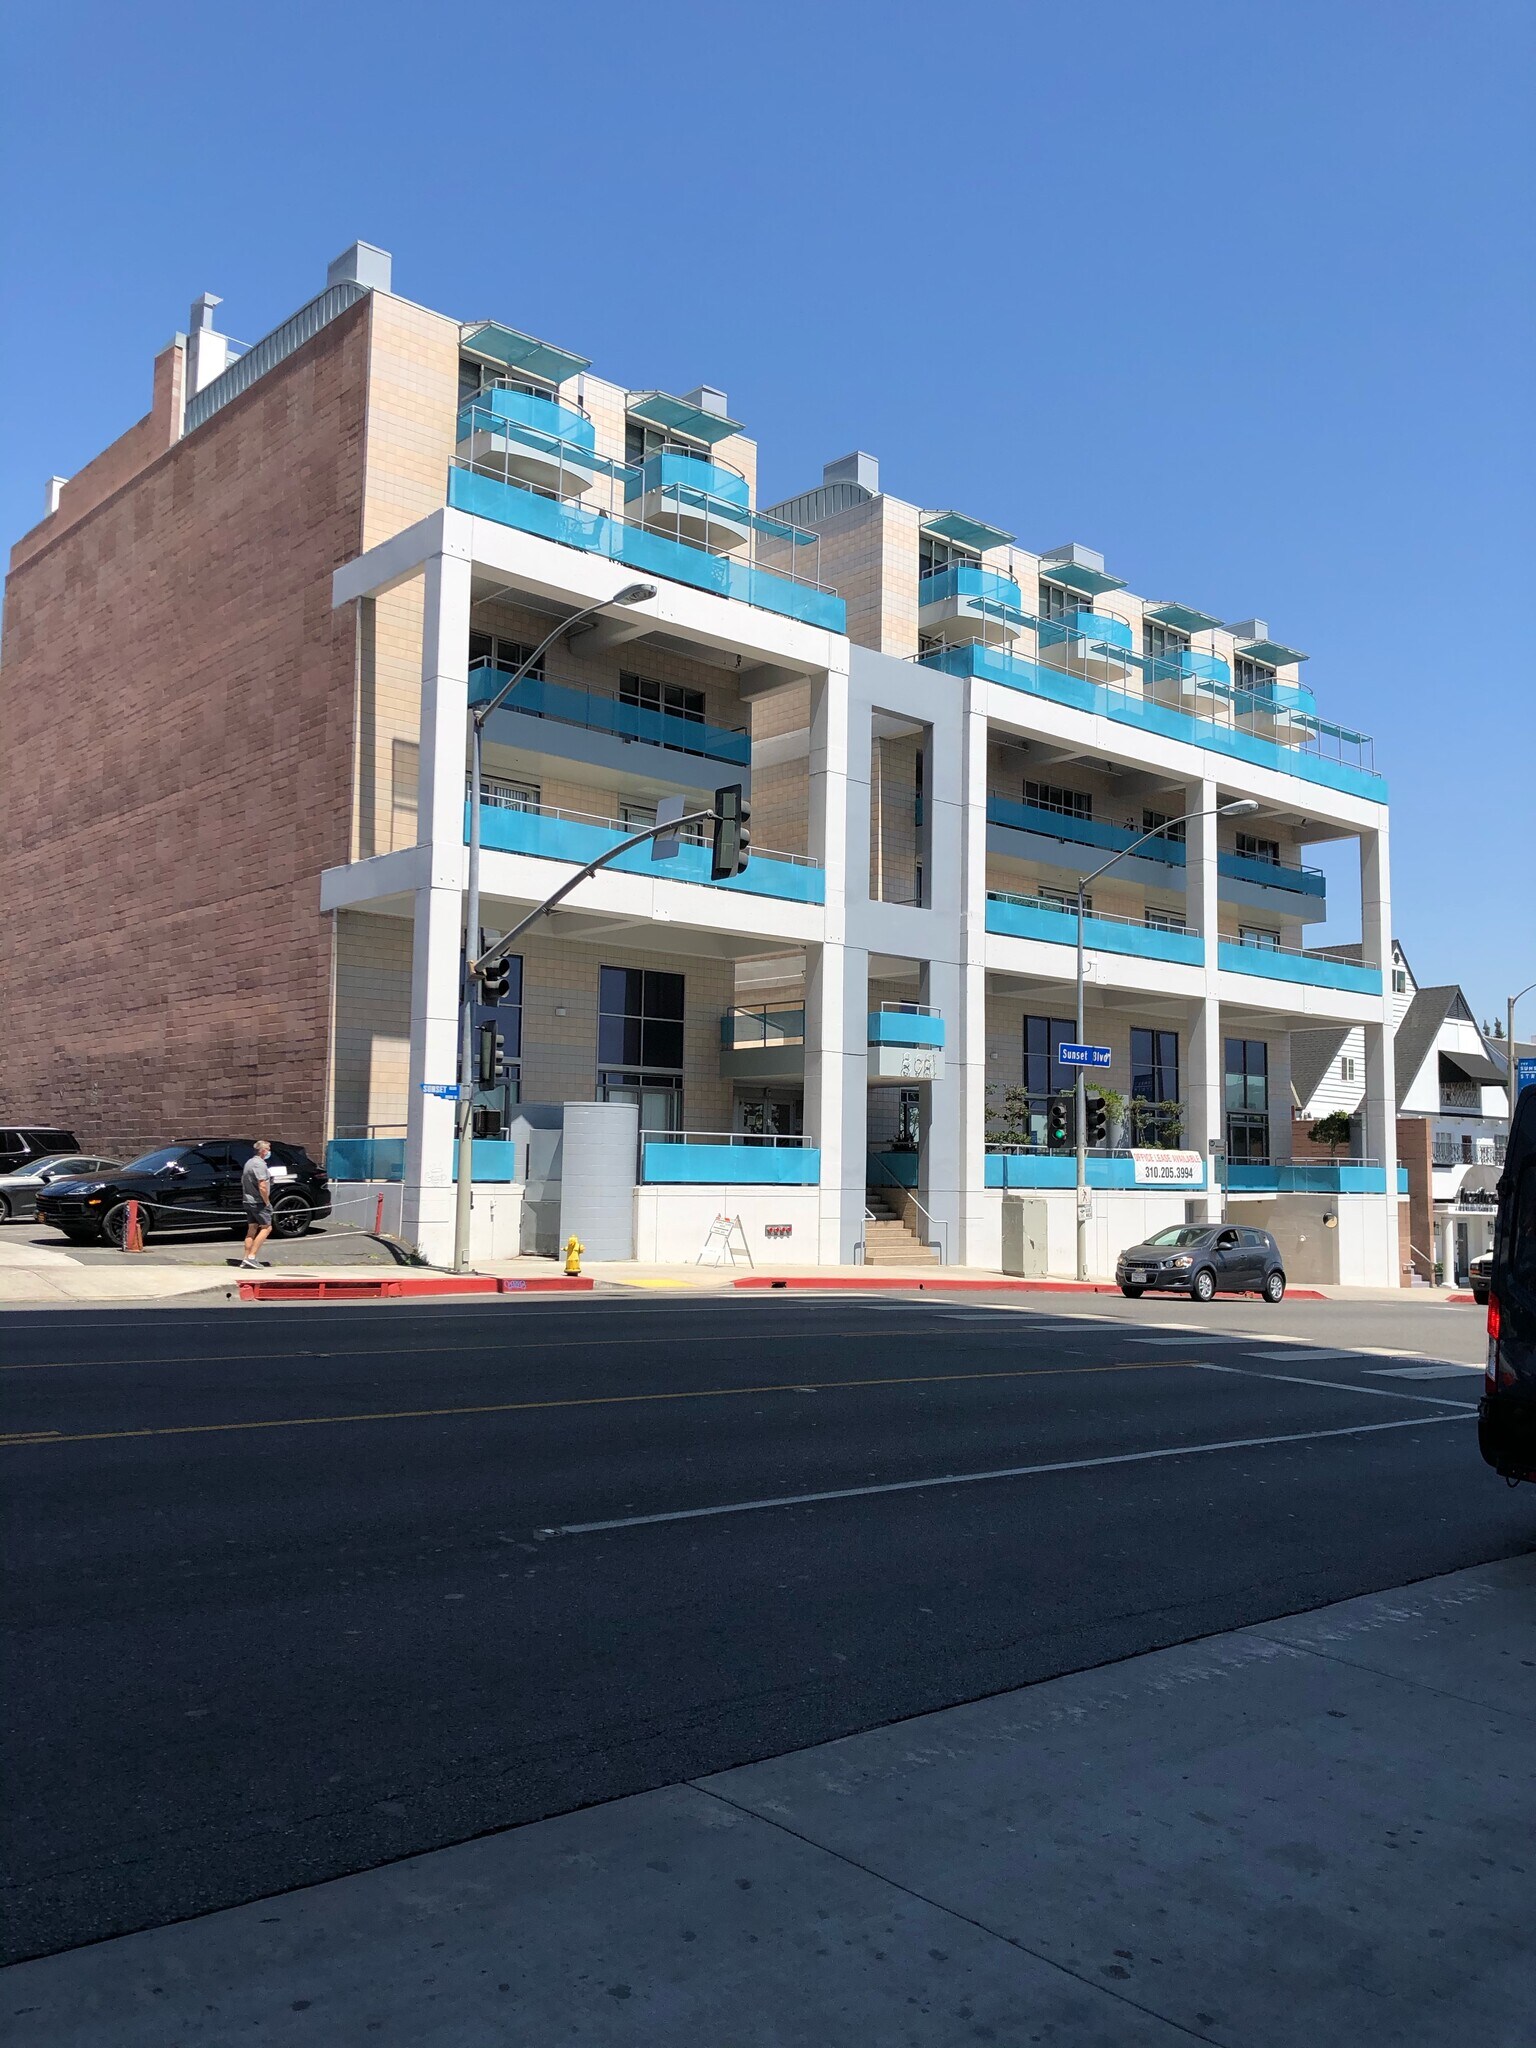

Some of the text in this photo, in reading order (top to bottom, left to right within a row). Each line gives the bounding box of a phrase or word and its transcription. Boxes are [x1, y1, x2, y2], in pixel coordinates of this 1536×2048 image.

[1063, 1049, 1088, 1061] Sunset
[423, 1085, 447, 1093] SUNSET
[1134, 1153, 1201, 1163] OFFICE LEASE AVAILABLE
[1145, 1166, 1193, 1179] 310.205.3994
